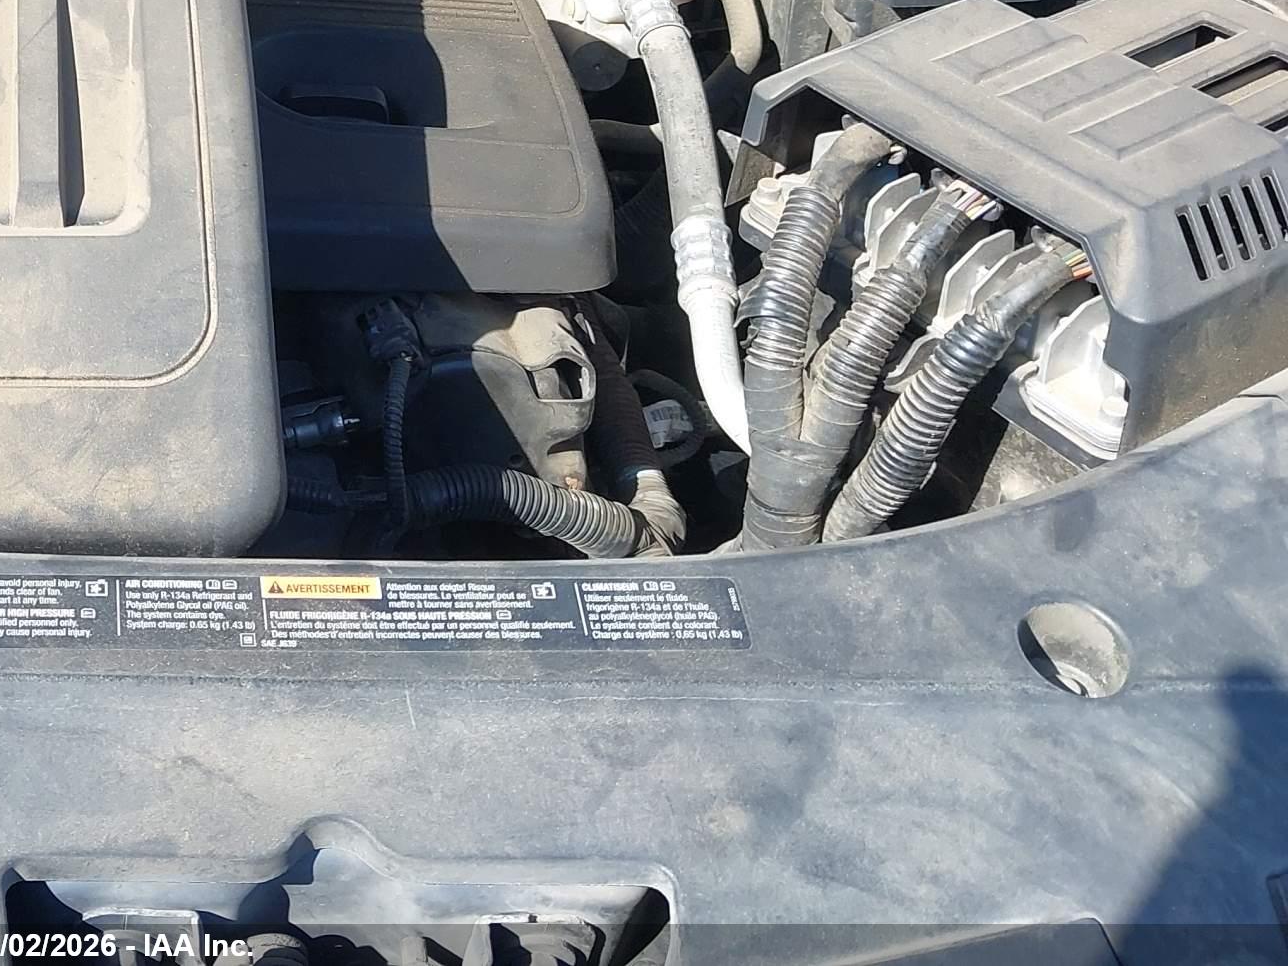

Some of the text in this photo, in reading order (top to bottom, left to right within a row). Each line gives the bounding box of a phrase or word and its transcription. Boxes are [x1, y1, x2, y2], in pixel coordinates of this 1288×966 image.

[0, 578, 21, 587] avoid
[22, 579, 56, 588] personal
[125, 579, 202, 589] AIR CONDITIONING
[386, 583, 421, 592] Attention
[423, 583, 438, 592] aux
[468, 583, 495, 592] Risque
[582, 583, 639, 591] CLIMATISEUR
[16, 587, 38, 596] clear
[40, 587, 47, 596] of
[286, 584, 370, 594] AVERTISSEMENT
[125, 591, 253, 600] Use only R-134a Refrigerant and
[387, 592, 526, 601] de blessures. Le ventilateur peut se
[584, 594, 689, 603] Utiliser seulement le fluide
[12, 596, 21, 604] at
[22, 597, 38, 605] any
[39, 596, 60, 604] time.
[388, 601, 533, 609] mettre à tourner sans avertissement.
[125, 601, 249, 610] Polyalkylene Glycol oil (PAG oil).
[586, 603, 629, 612] frigorigène
[630, 603, 661, 612] R-134a
[663, 603, 671, 612] et
[673, 603, 683, 612] de
[7, 608, 29, 617] HIGH
[30, 608, 75, 617] PRESSURE
[126, 611, 226, 620] The system contains dye.
[269, 611, 491, 620] FLUIDE FRIGORIGÈNE R-134a SOUS HAUTE PRESSION
[18, 618, 58, 627] personnel
[59, 618, 79, 627] only.
[126, 621, 156, 630] System
[158, 621, 188, 630] charge:
[210, 621, 220, 630] kg
[222, 621, 243, 630] (1.43
[245, 621, 255, 630] lb)
[271, 621, 576, 630] L'entretien du système doit être effectué par un personnel qualifié seulement.
[591, 622, 720, 631] Le système contient du colorant.
[6, 628, 30, 637] cause
[32, 628, 66, 637] personal
[272, 631, 287, 639] Des
[375, 631, 421, 639] incorrectes
[422, 631, 454, 639] peuvent
[455, 631, 482, 639] causer
[484, 631, 499, 639] des
[592, 631, 622, 640] Charge
[623, 631, 633, 640] du
[635, 631, 669, 640] système
[697, 631, 707, 640] kg
[731, 631, 743, 640] lb)
[261, 639, 277, 647] SAE
